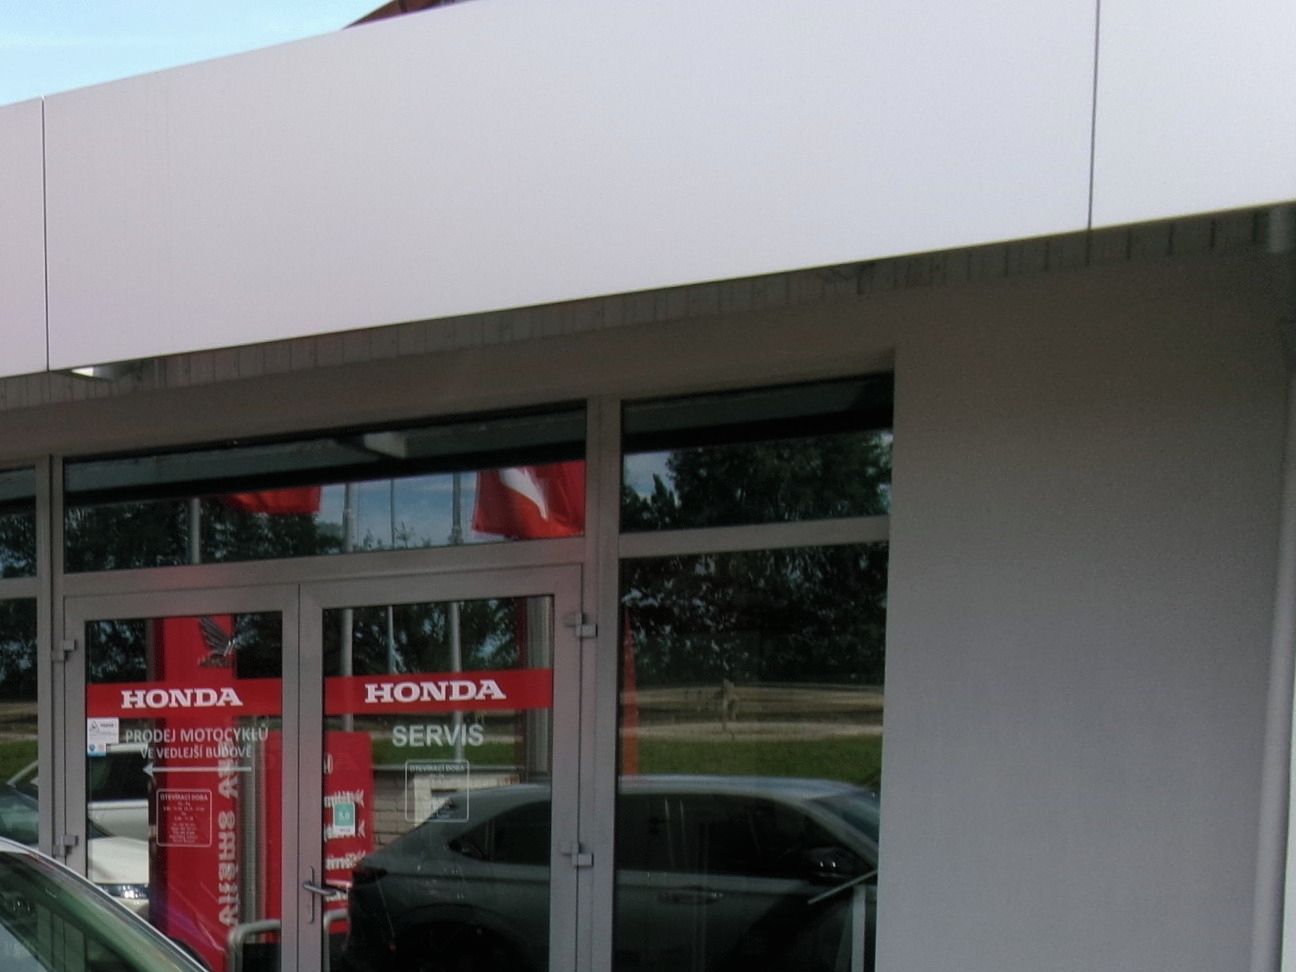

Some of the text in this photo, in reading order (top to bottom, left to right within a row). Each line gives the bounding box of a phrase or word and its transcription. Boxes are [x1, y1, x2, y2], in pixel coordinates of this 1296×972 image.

[120, 687, 243, 709] HONDA
[365, 679, 507, 704] HONDA
[125, 723, 269, 743] PRODEJ MOTOCYKLŮ
[392, 724, 484, 747] SERVIS
[141, 743, 252, 759] VE VEDLEJŠÍ BUDOVĚ
